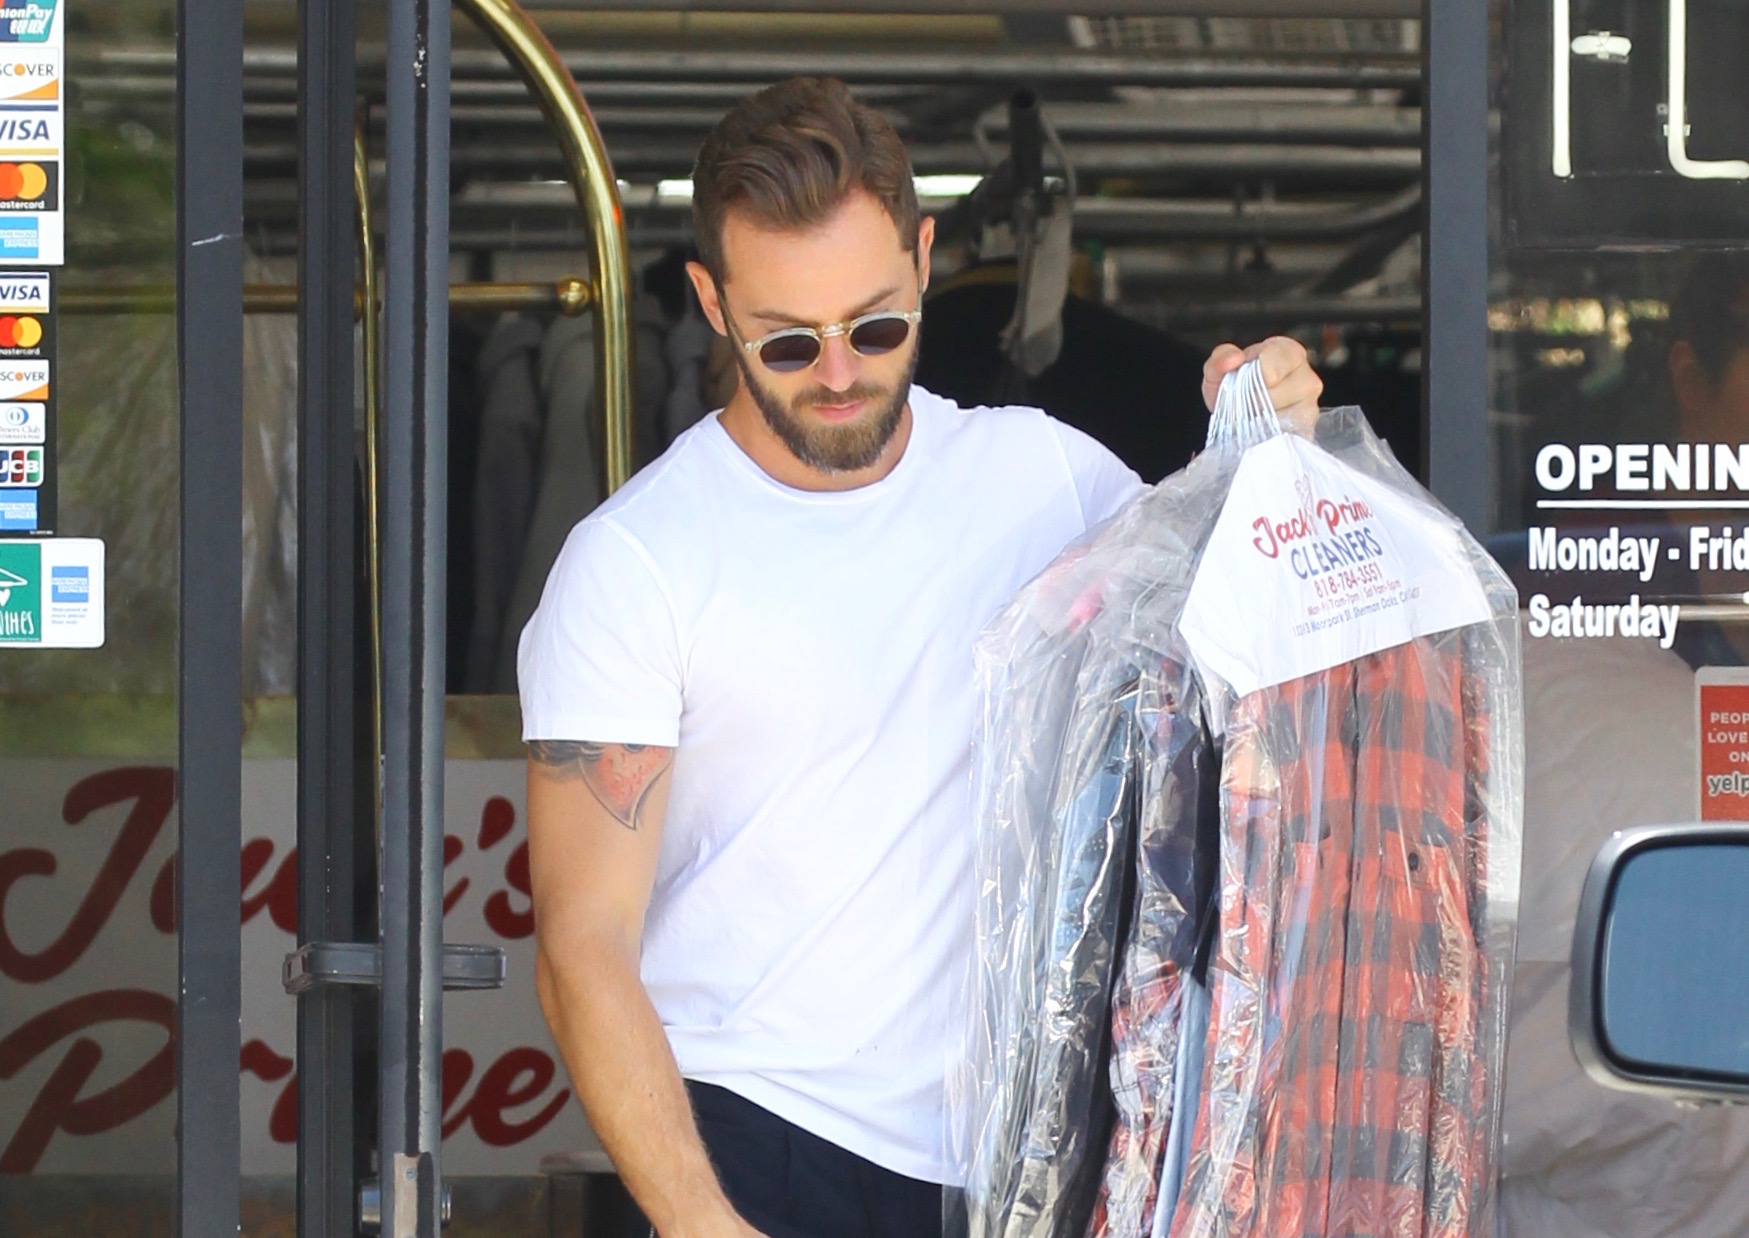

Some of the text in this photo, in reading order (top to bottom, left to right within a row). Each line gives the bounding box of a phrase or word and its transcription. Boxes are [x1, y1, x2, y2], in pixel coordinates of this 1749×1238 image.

[0, 63, 54, 76] COVER
[0, 285, 41, 300] VISA
[0, 460, 39, 474] JCB
[1535, 443, 1749, 491] OPENIN
[1291, 526, 1383, 580] CLEANERS
[1528, 526, 1660, 582] Monday
[1690, 526, 1749, 571] Frid
[1313, 561, 1384, 599] 818-784-3551
[1528, 593, 1680, 649] Saturday
[1710, 713, 1749, 724] PEOP
[1708, 733, 1748, 743] LOVE
[1729, 752, 1749, 762] ON
[1708, 772, 1749, 796] yelp
